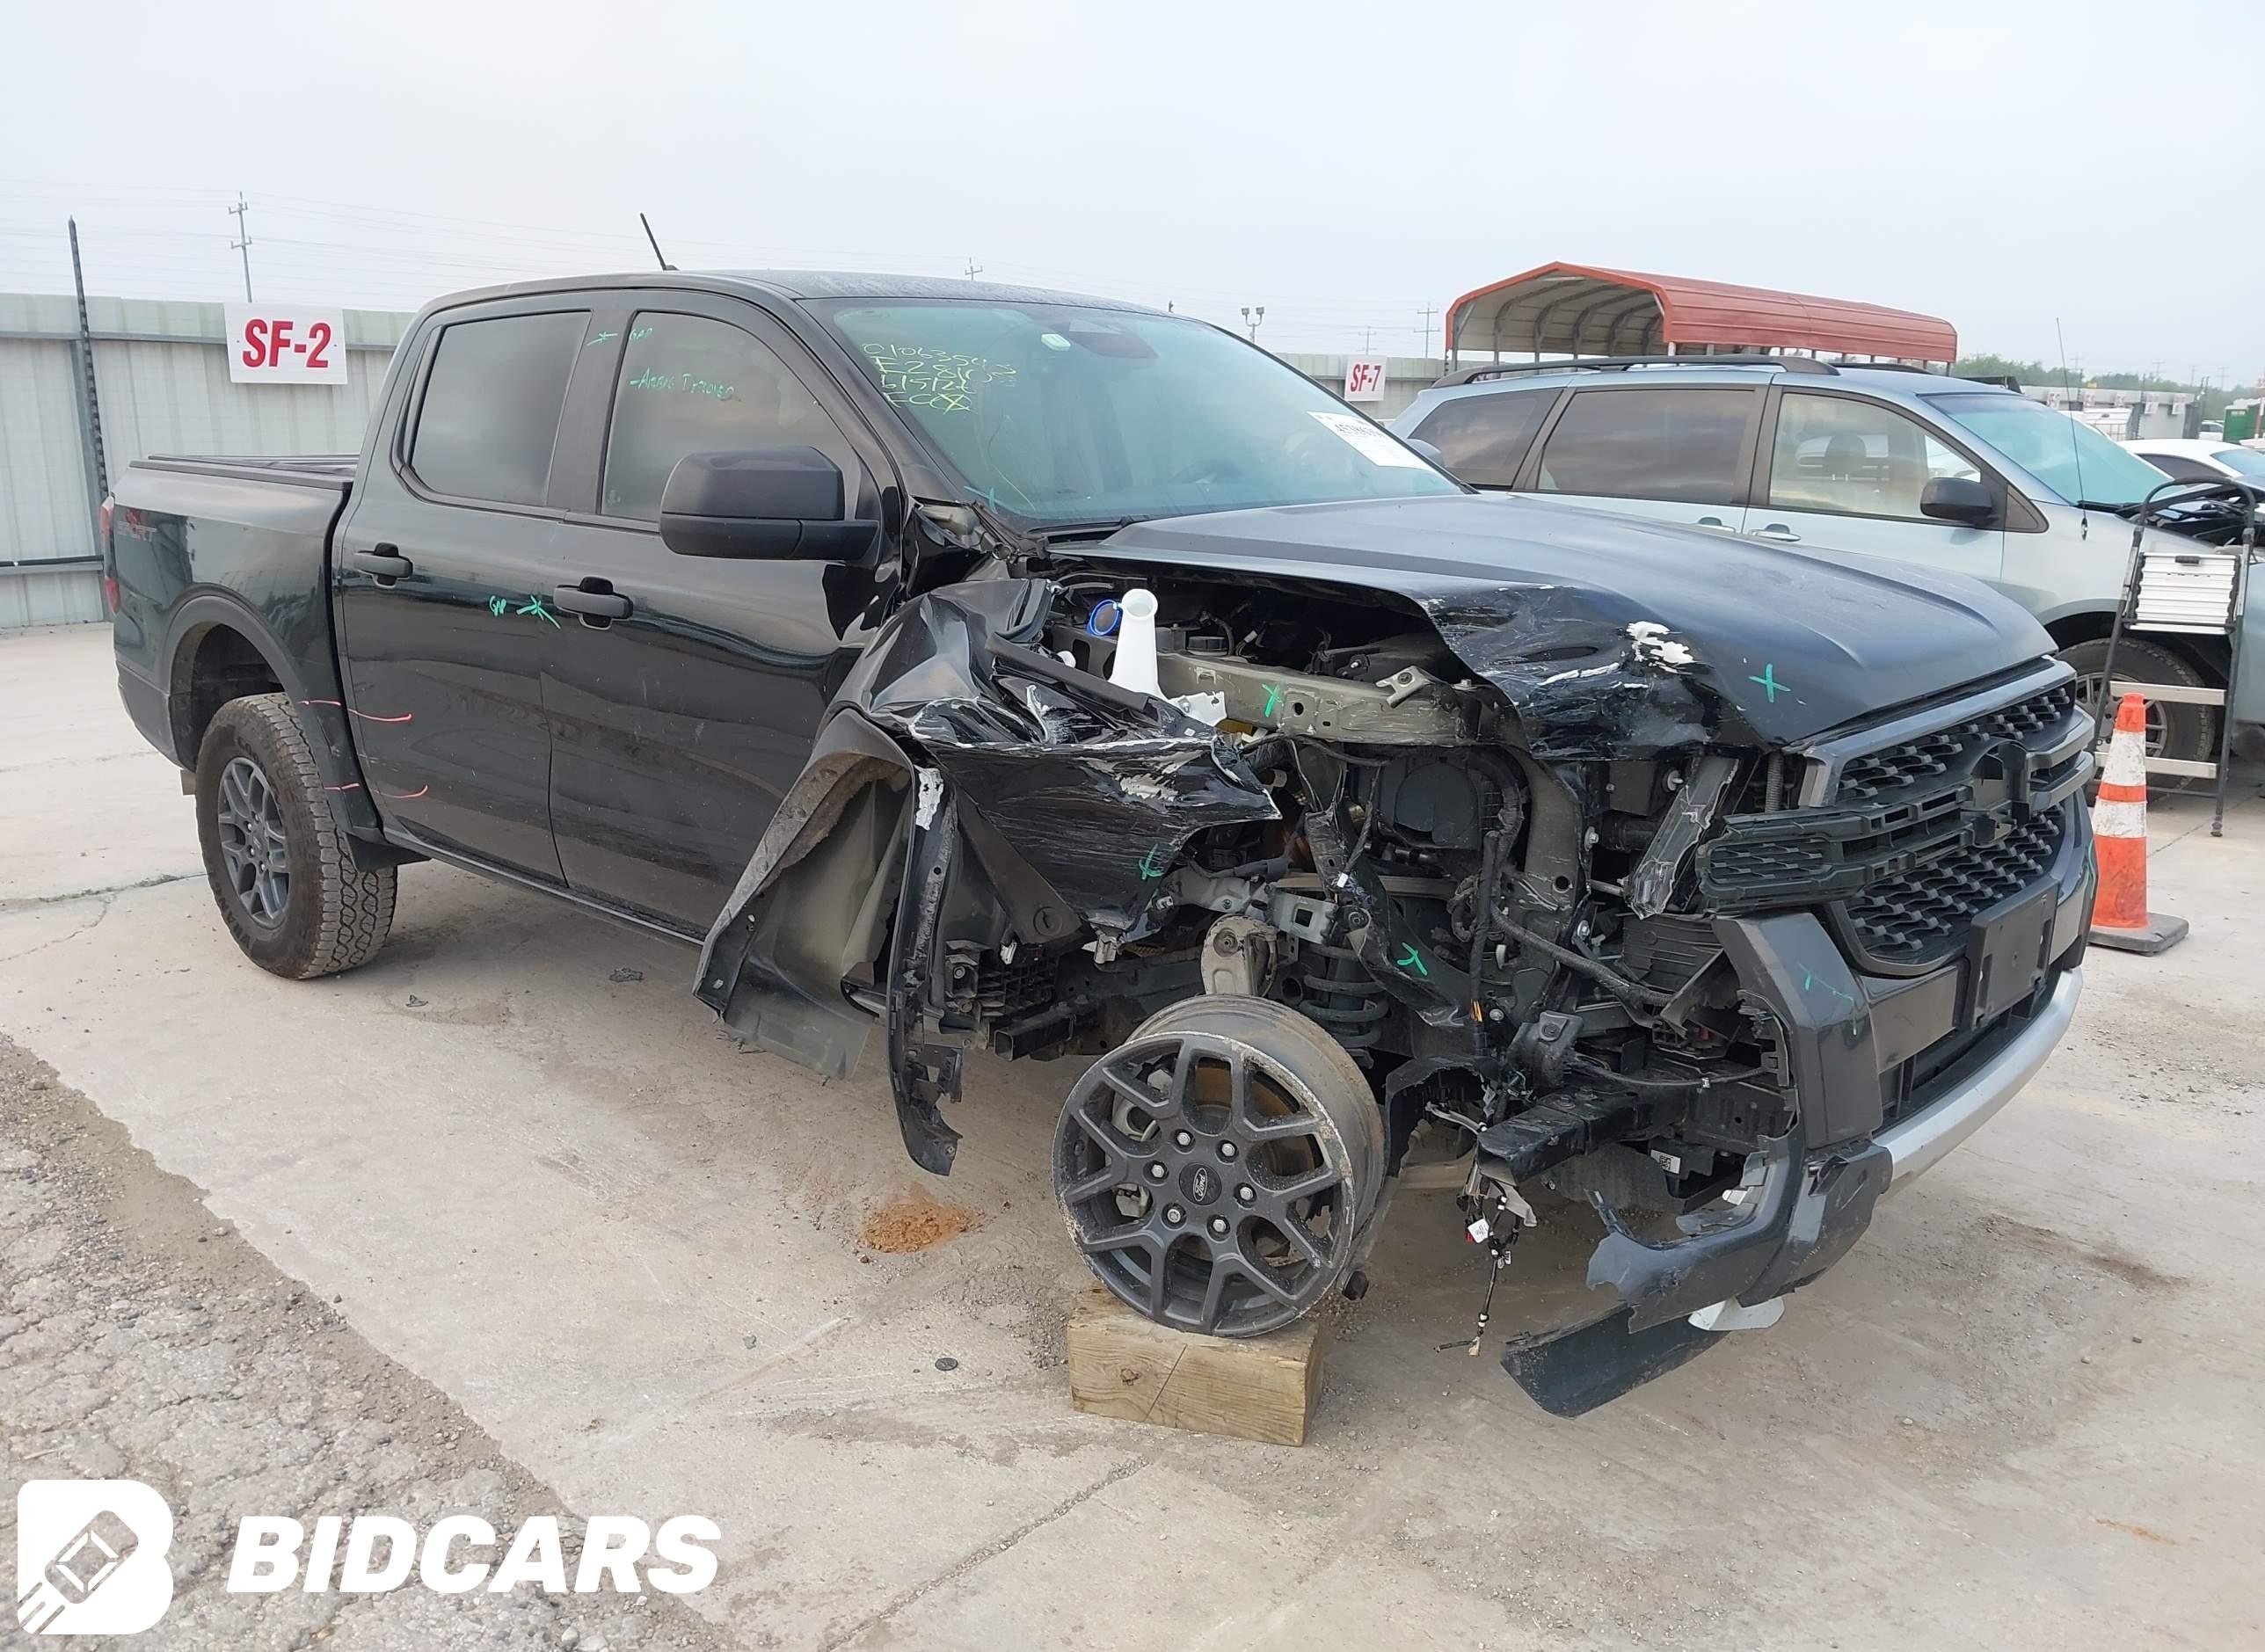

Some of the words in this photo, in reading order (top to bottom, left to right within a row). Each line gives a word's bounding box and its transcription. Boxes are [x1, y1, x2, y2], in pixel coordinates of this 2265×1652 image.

[242, 317, 332, 368] SF-2
[1350, 363, 1382, 392] SF-7
[1194, 1171, 1206, 1198] Ford
